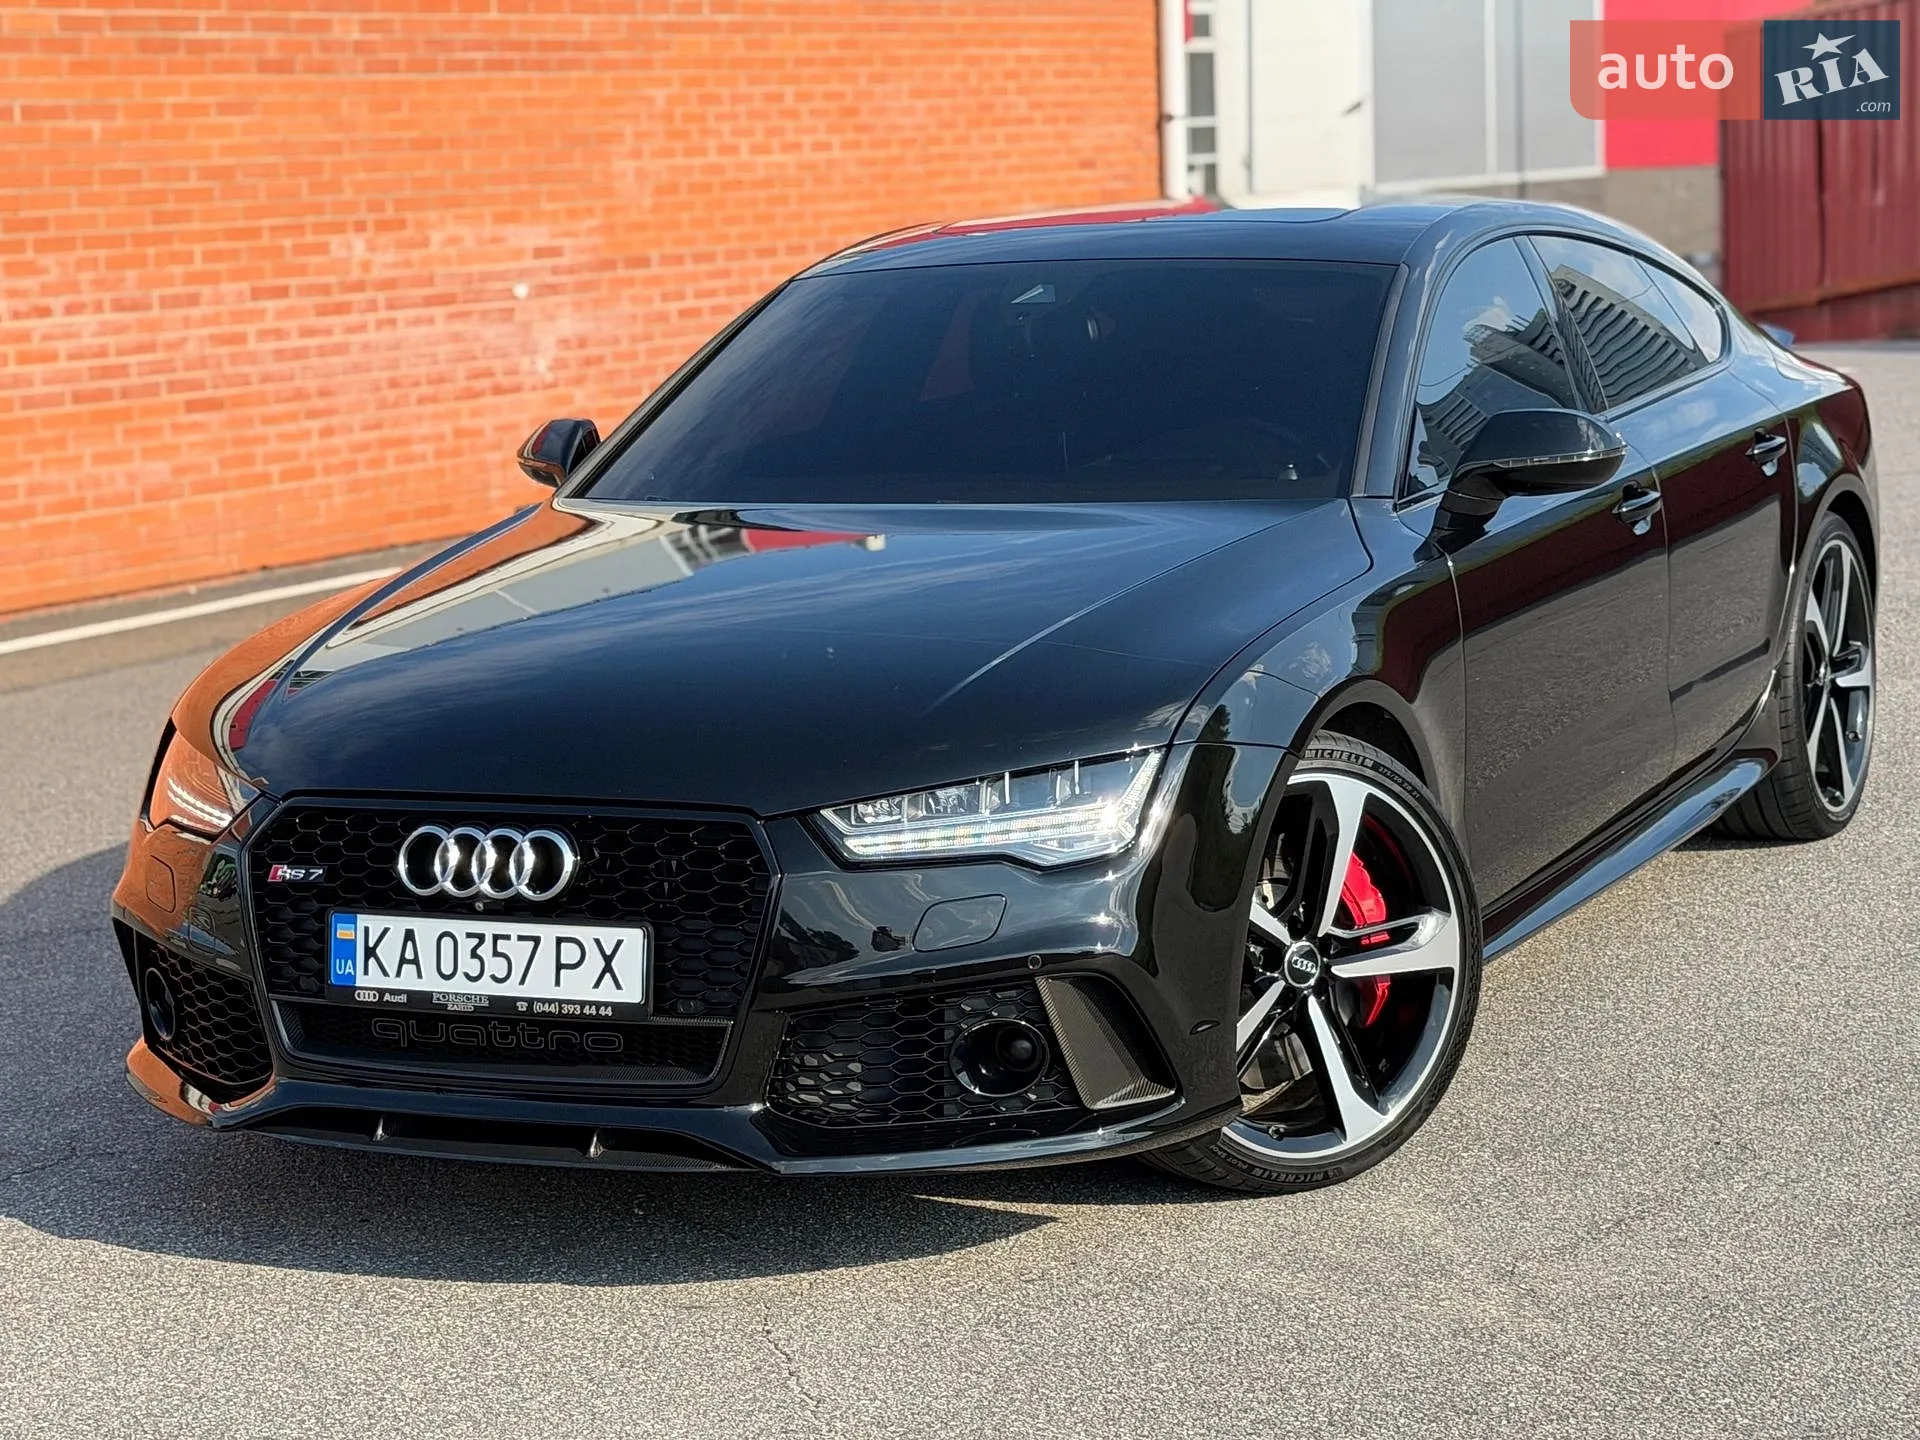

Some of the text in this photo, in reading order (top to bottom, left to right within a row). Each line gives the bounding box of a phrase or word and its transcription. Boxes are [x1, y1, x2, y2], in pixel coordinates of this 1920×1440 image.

[1304, 749, 1375, 768] MICHELIN
[363, 925, 625, 991] KA 0357 PX
[335, 958, 355, 976] UA
[383, 992, 408, 1003] Audi
[432, 992, 490, 1004] PORSCHE
[533, 1001, 612, 1017] (044) 393 44 44
[371, 1017, 625, 1053] quattro
[1252, 1167, 1325, 1183] MICHELIN
